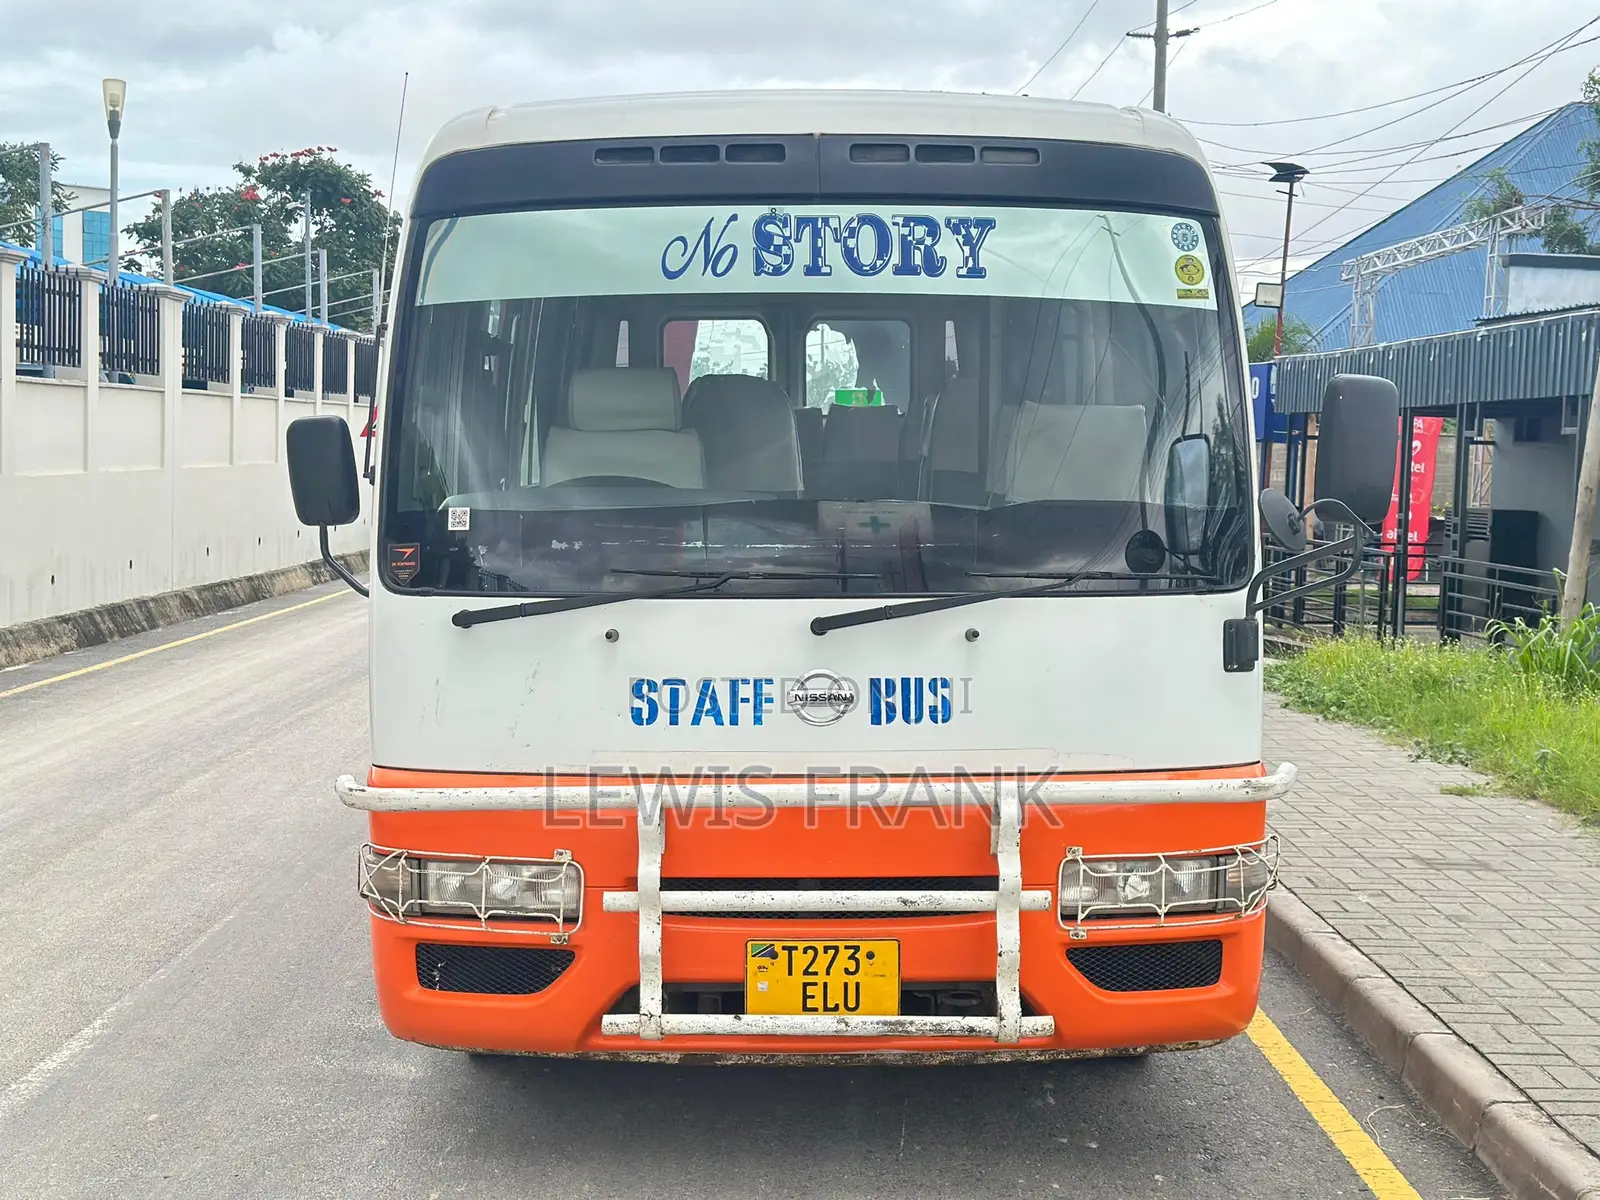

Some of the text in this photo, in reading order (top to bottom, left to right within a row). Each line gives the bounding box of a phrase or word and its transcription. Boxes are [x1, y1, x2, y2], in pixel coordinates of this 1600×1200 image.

[661, 212, 996, 280] No STORY
[630, 677, 952, 726] STAFF BUS
[794, 693, 848, 702] NISSAN
[782, 945, 861, 976] T273
[802, 981, 861, 1012] ELU
